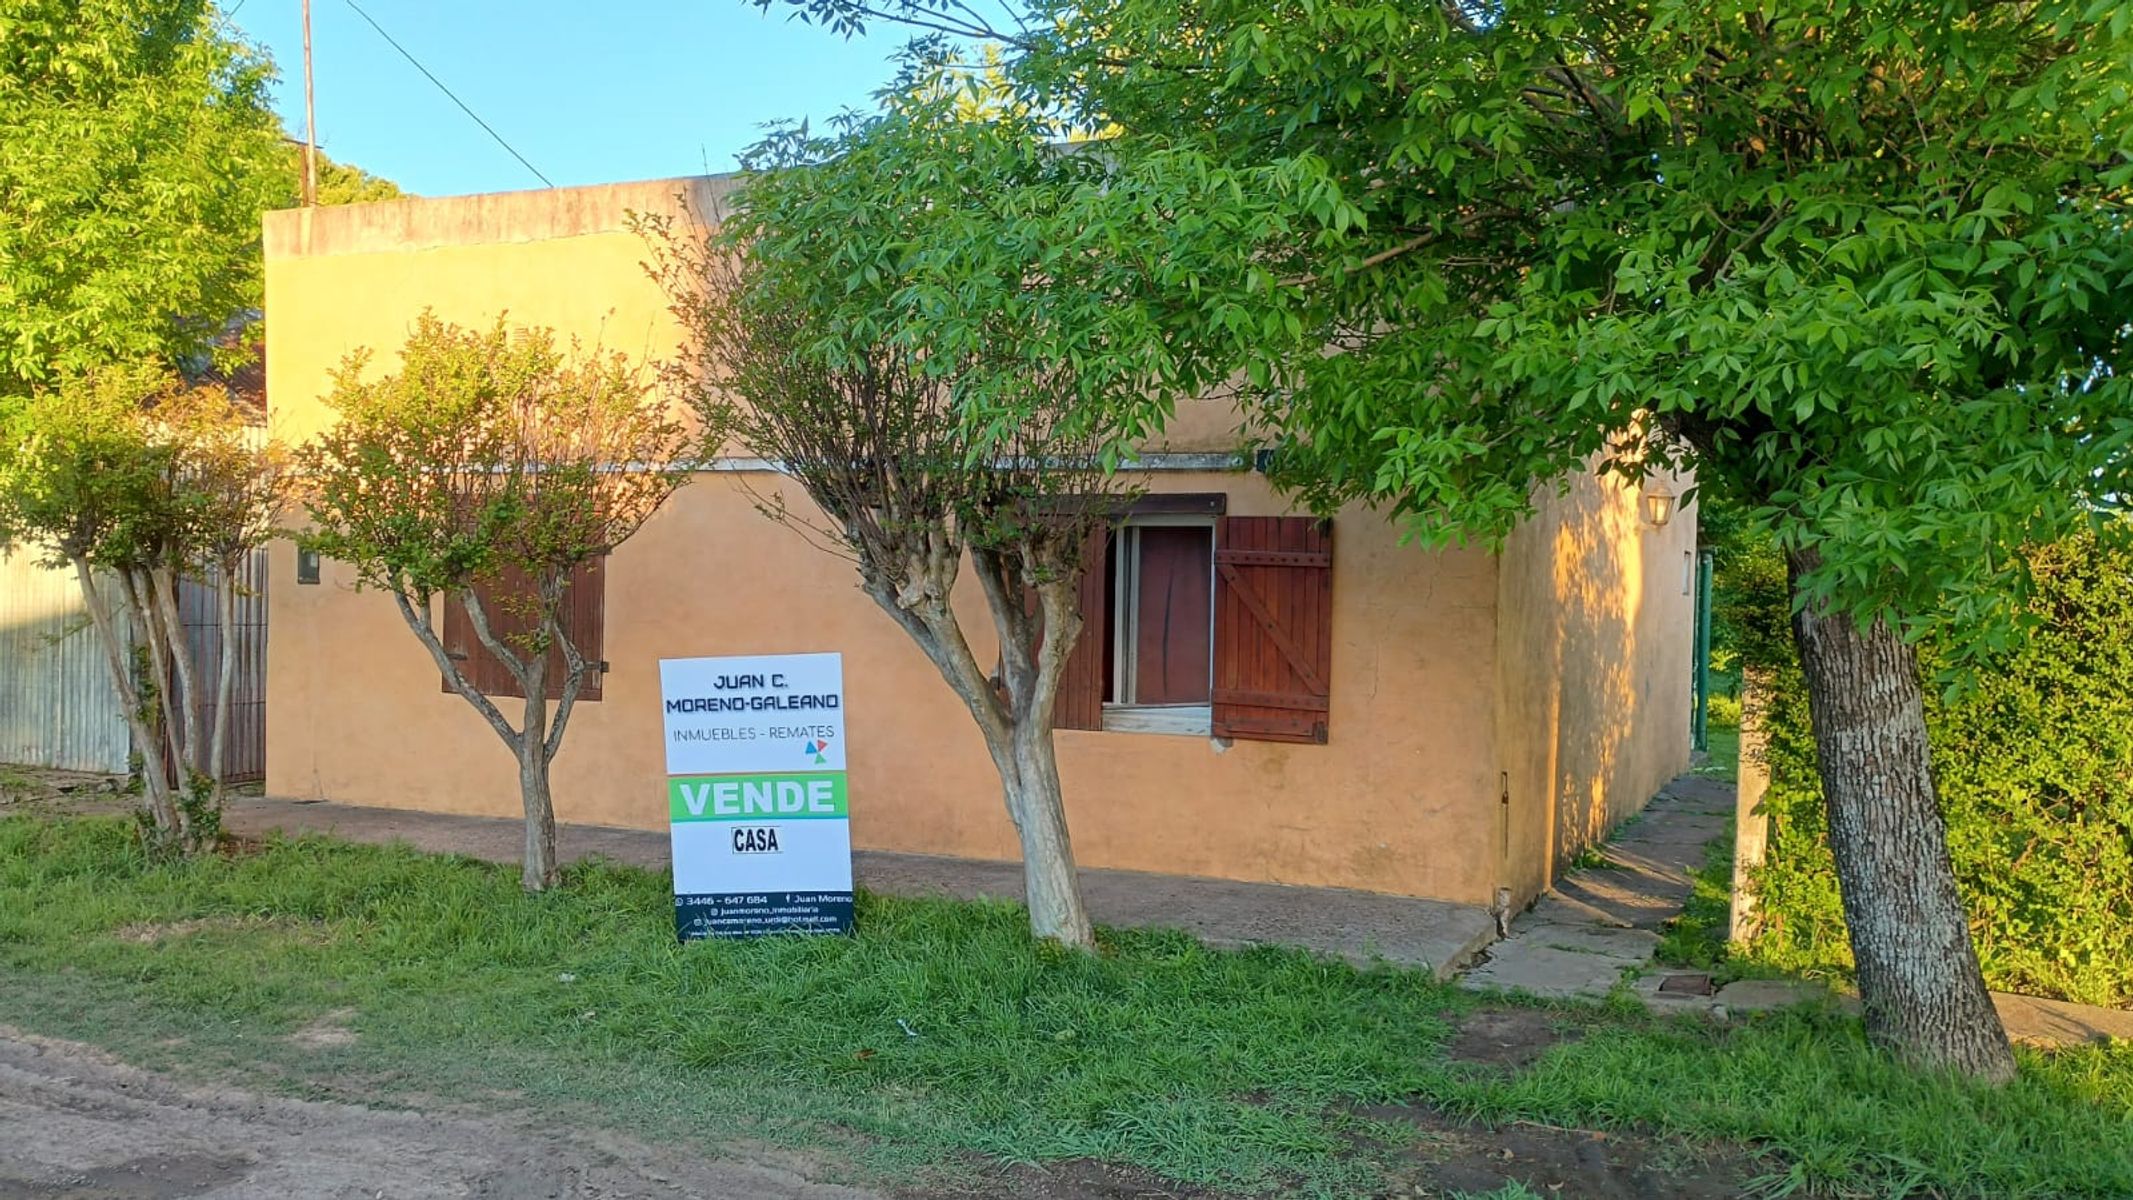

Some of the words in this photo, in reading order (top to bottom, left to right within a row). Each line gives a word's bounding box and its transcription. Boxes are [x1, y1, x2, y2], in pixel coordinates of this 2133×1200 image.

[713, 674, 764, 689] JUAN
[771, 674, 788, 687] C.
[666, 694, 838, 713] MORENO-GALEANO
[673, 727, 756, 742] INMUEBLES
[769, 725, 835, 739] REMATES
[679, 780, 835, 815] VENDE
[734, 828, 779, 852] CASA
[686, 896, 714, 905] 3446
[724, 896, 744, 904] 647
[746, 896, 768, 904] 684
[794, 895, 816, 903] Juan
[818, 895, 853, 903] Moreno
